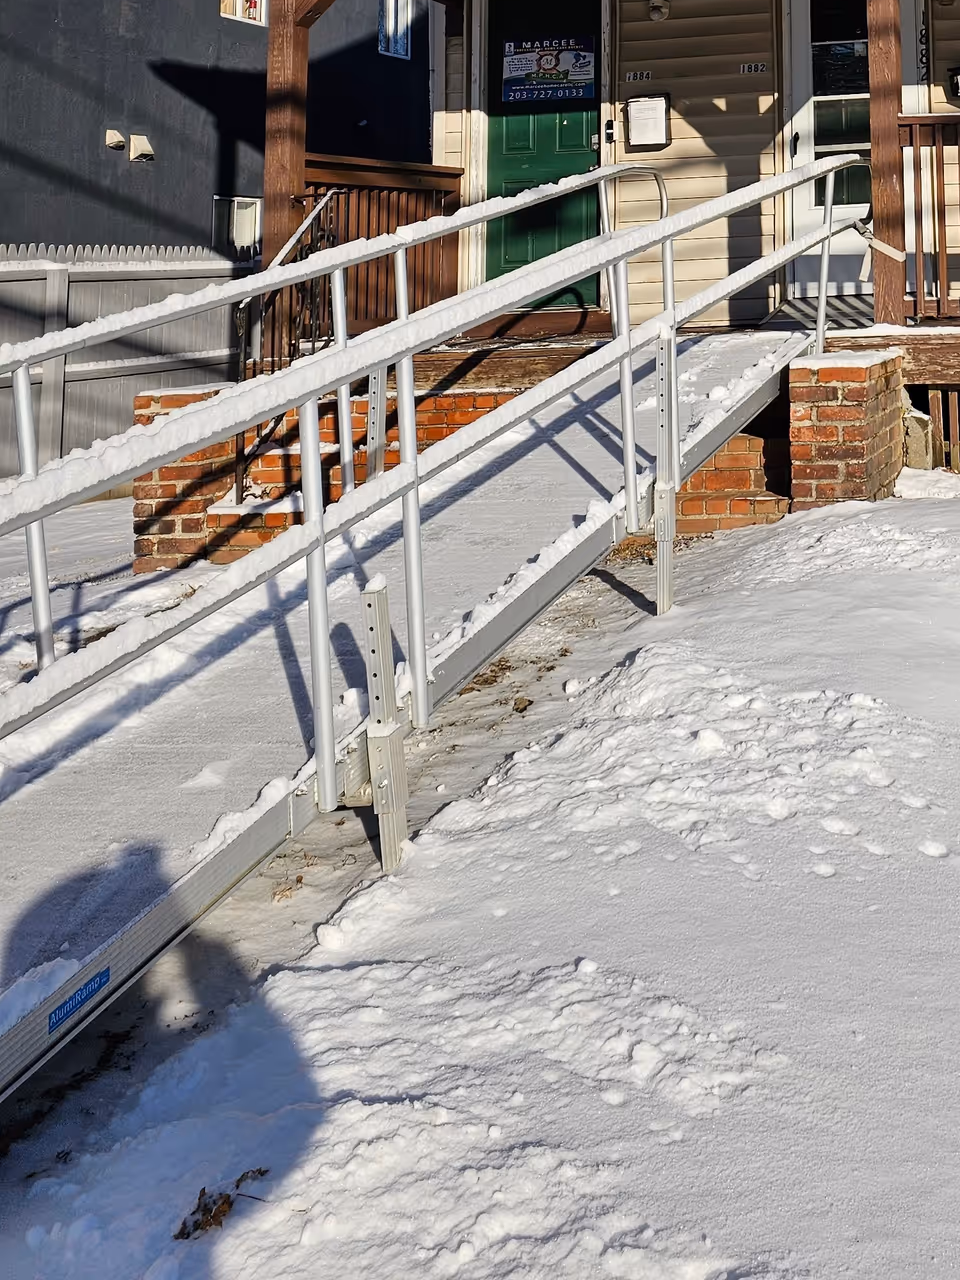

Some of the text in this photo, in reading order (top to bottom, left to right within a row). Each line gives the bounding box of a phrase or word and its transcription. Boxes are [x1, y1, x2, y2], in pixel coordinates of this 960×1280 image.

[522, 39, 576, 49] MARCEE
[741, 64, 766, 73] 1882
[627, 72, 651, 81] 1884
[508, 88, 584, 100] 203-727-0133
